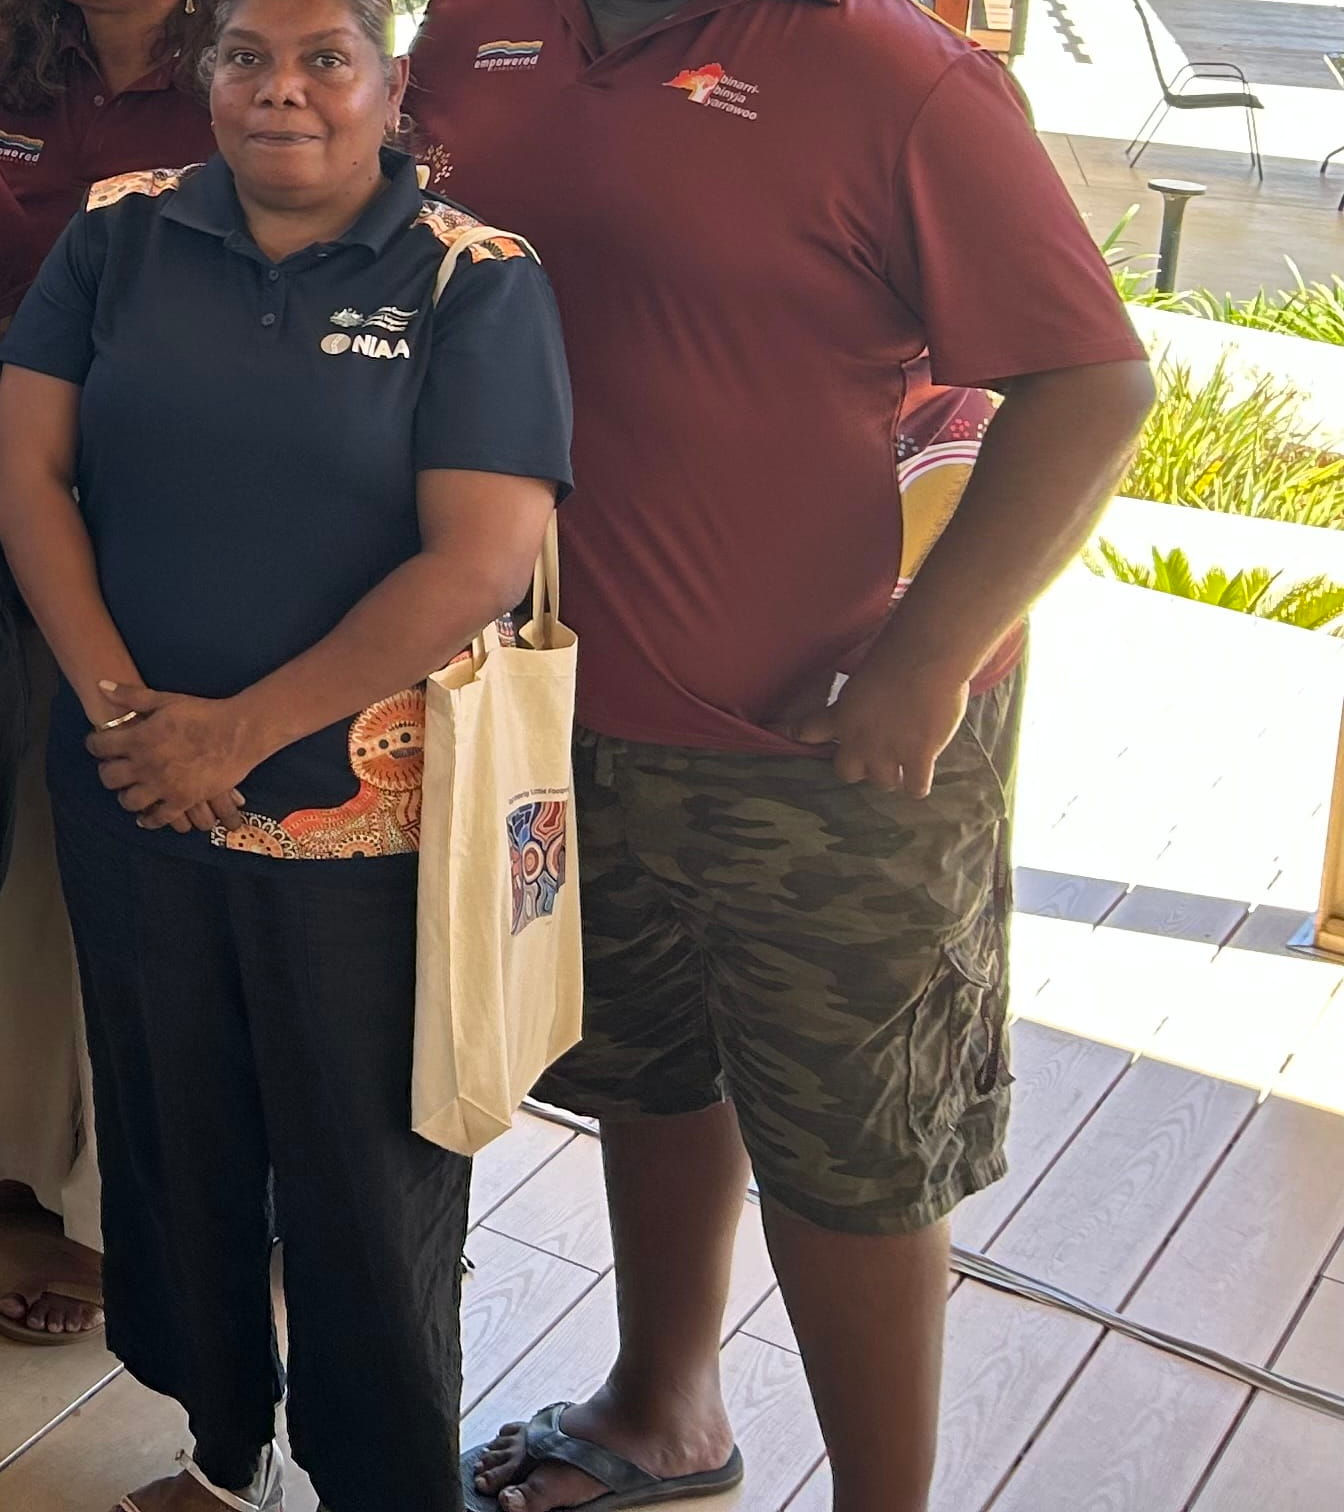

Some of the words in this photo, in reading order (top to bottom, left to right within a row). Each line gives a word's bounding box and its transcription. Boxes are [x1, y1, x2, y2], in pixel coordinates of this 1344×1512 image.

[474, 55, 540, 72] empowered
[713, 85, 746, 103] binyja
[704, 97, 758, 120] yarrawoo
[352, 334, 410, 359] NIAA
